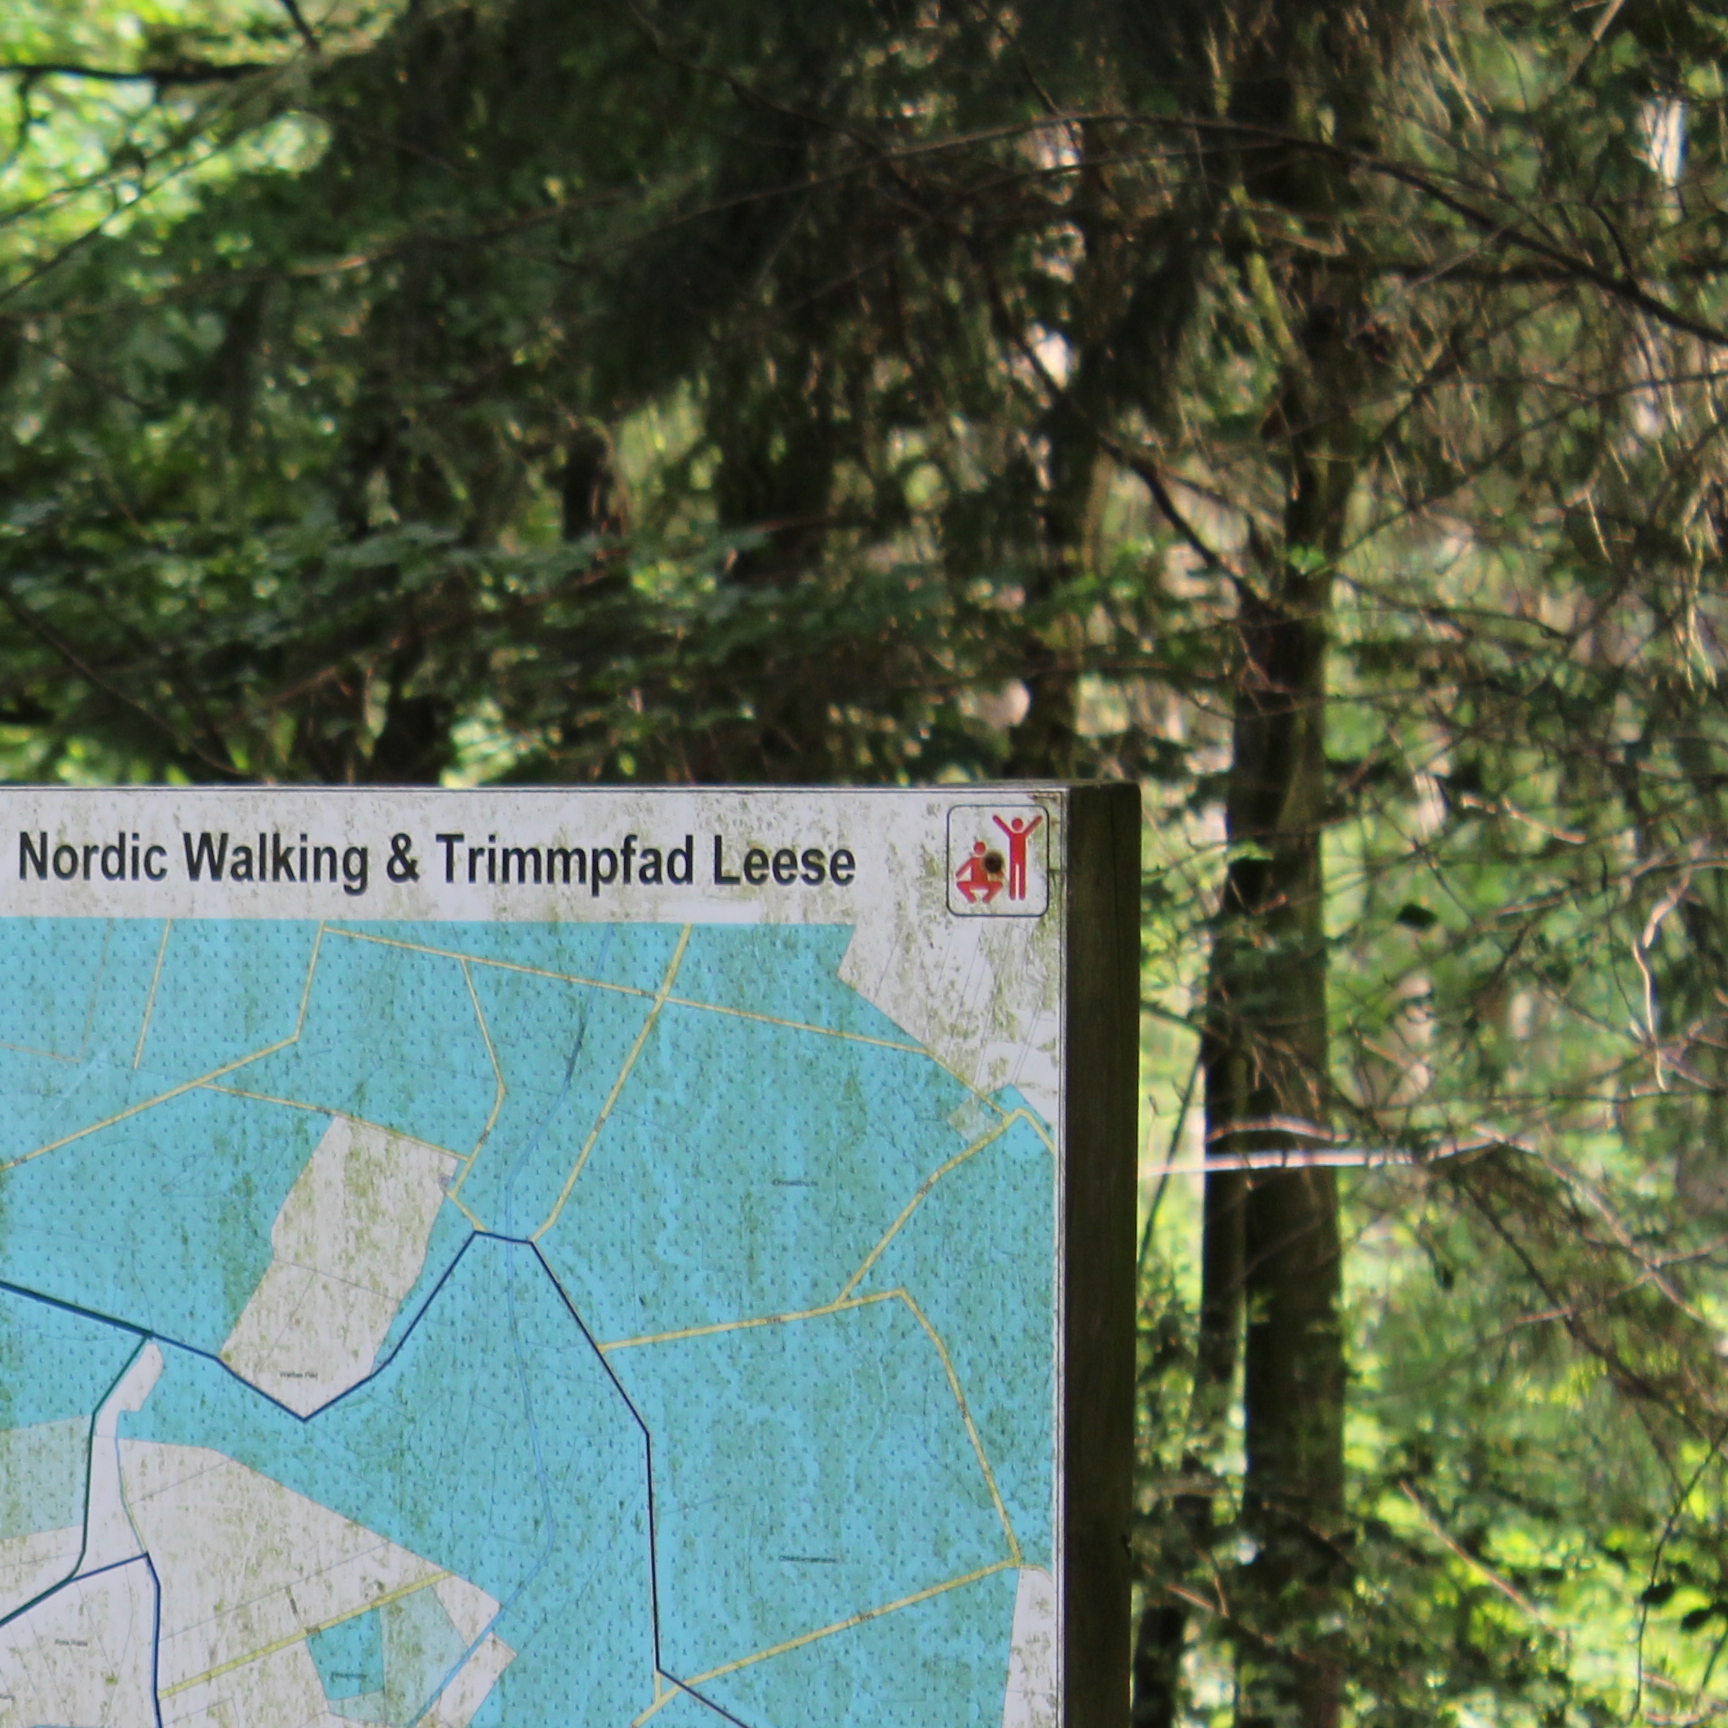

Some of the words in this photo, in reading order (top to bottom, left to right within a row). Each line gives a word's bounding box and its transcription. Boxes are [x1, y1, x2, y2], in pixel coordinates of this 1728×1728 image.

[18, 830, 168, 882] Nordic
[183, 830, 369, 897] Walking
[386, 832, 420, 884] &
[435, 833, 695, 898] Trimmpfad
[713, 834, 856, 886] Leese
